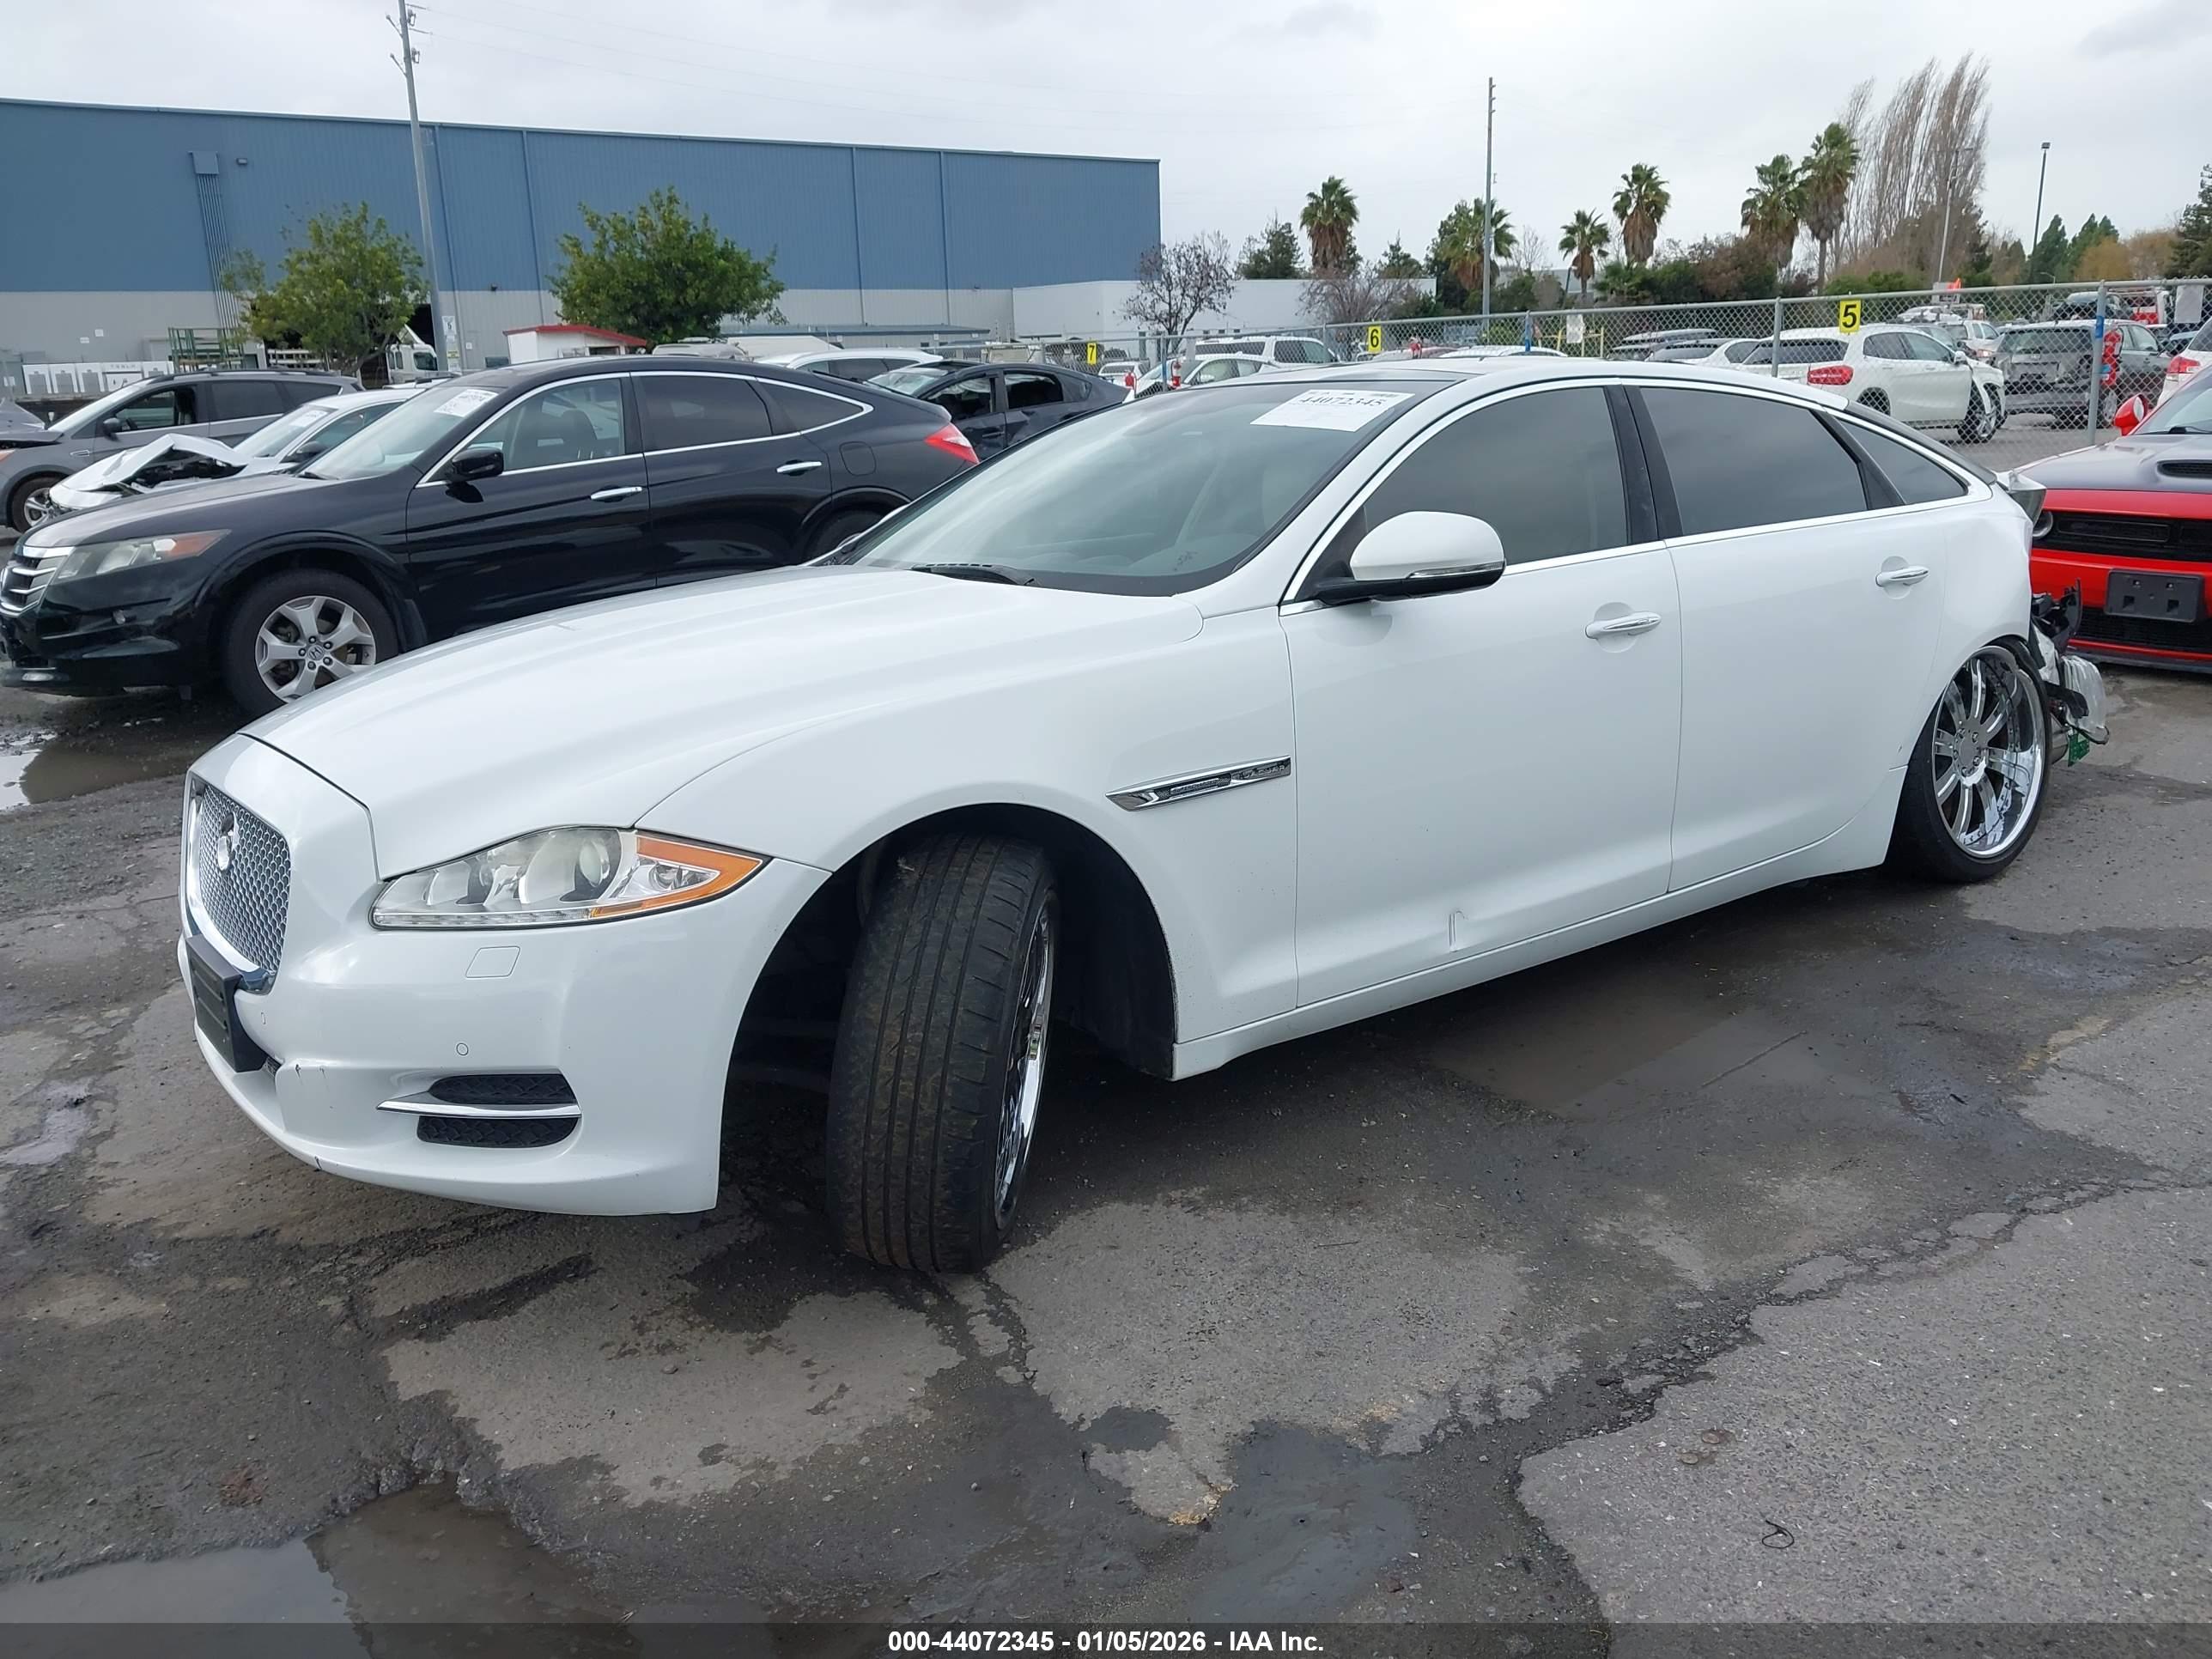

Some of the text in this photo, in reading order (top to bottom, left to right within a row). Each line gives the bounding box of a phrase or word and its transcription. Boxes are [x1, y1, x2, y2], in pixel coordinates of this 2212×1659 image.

[1842, 304, 1857, 328] 5
[1370, 329, 1379, 348] 6
[1089, 344, 1096, 362] 7
[1298, 396, 1387, 406] 44072345
